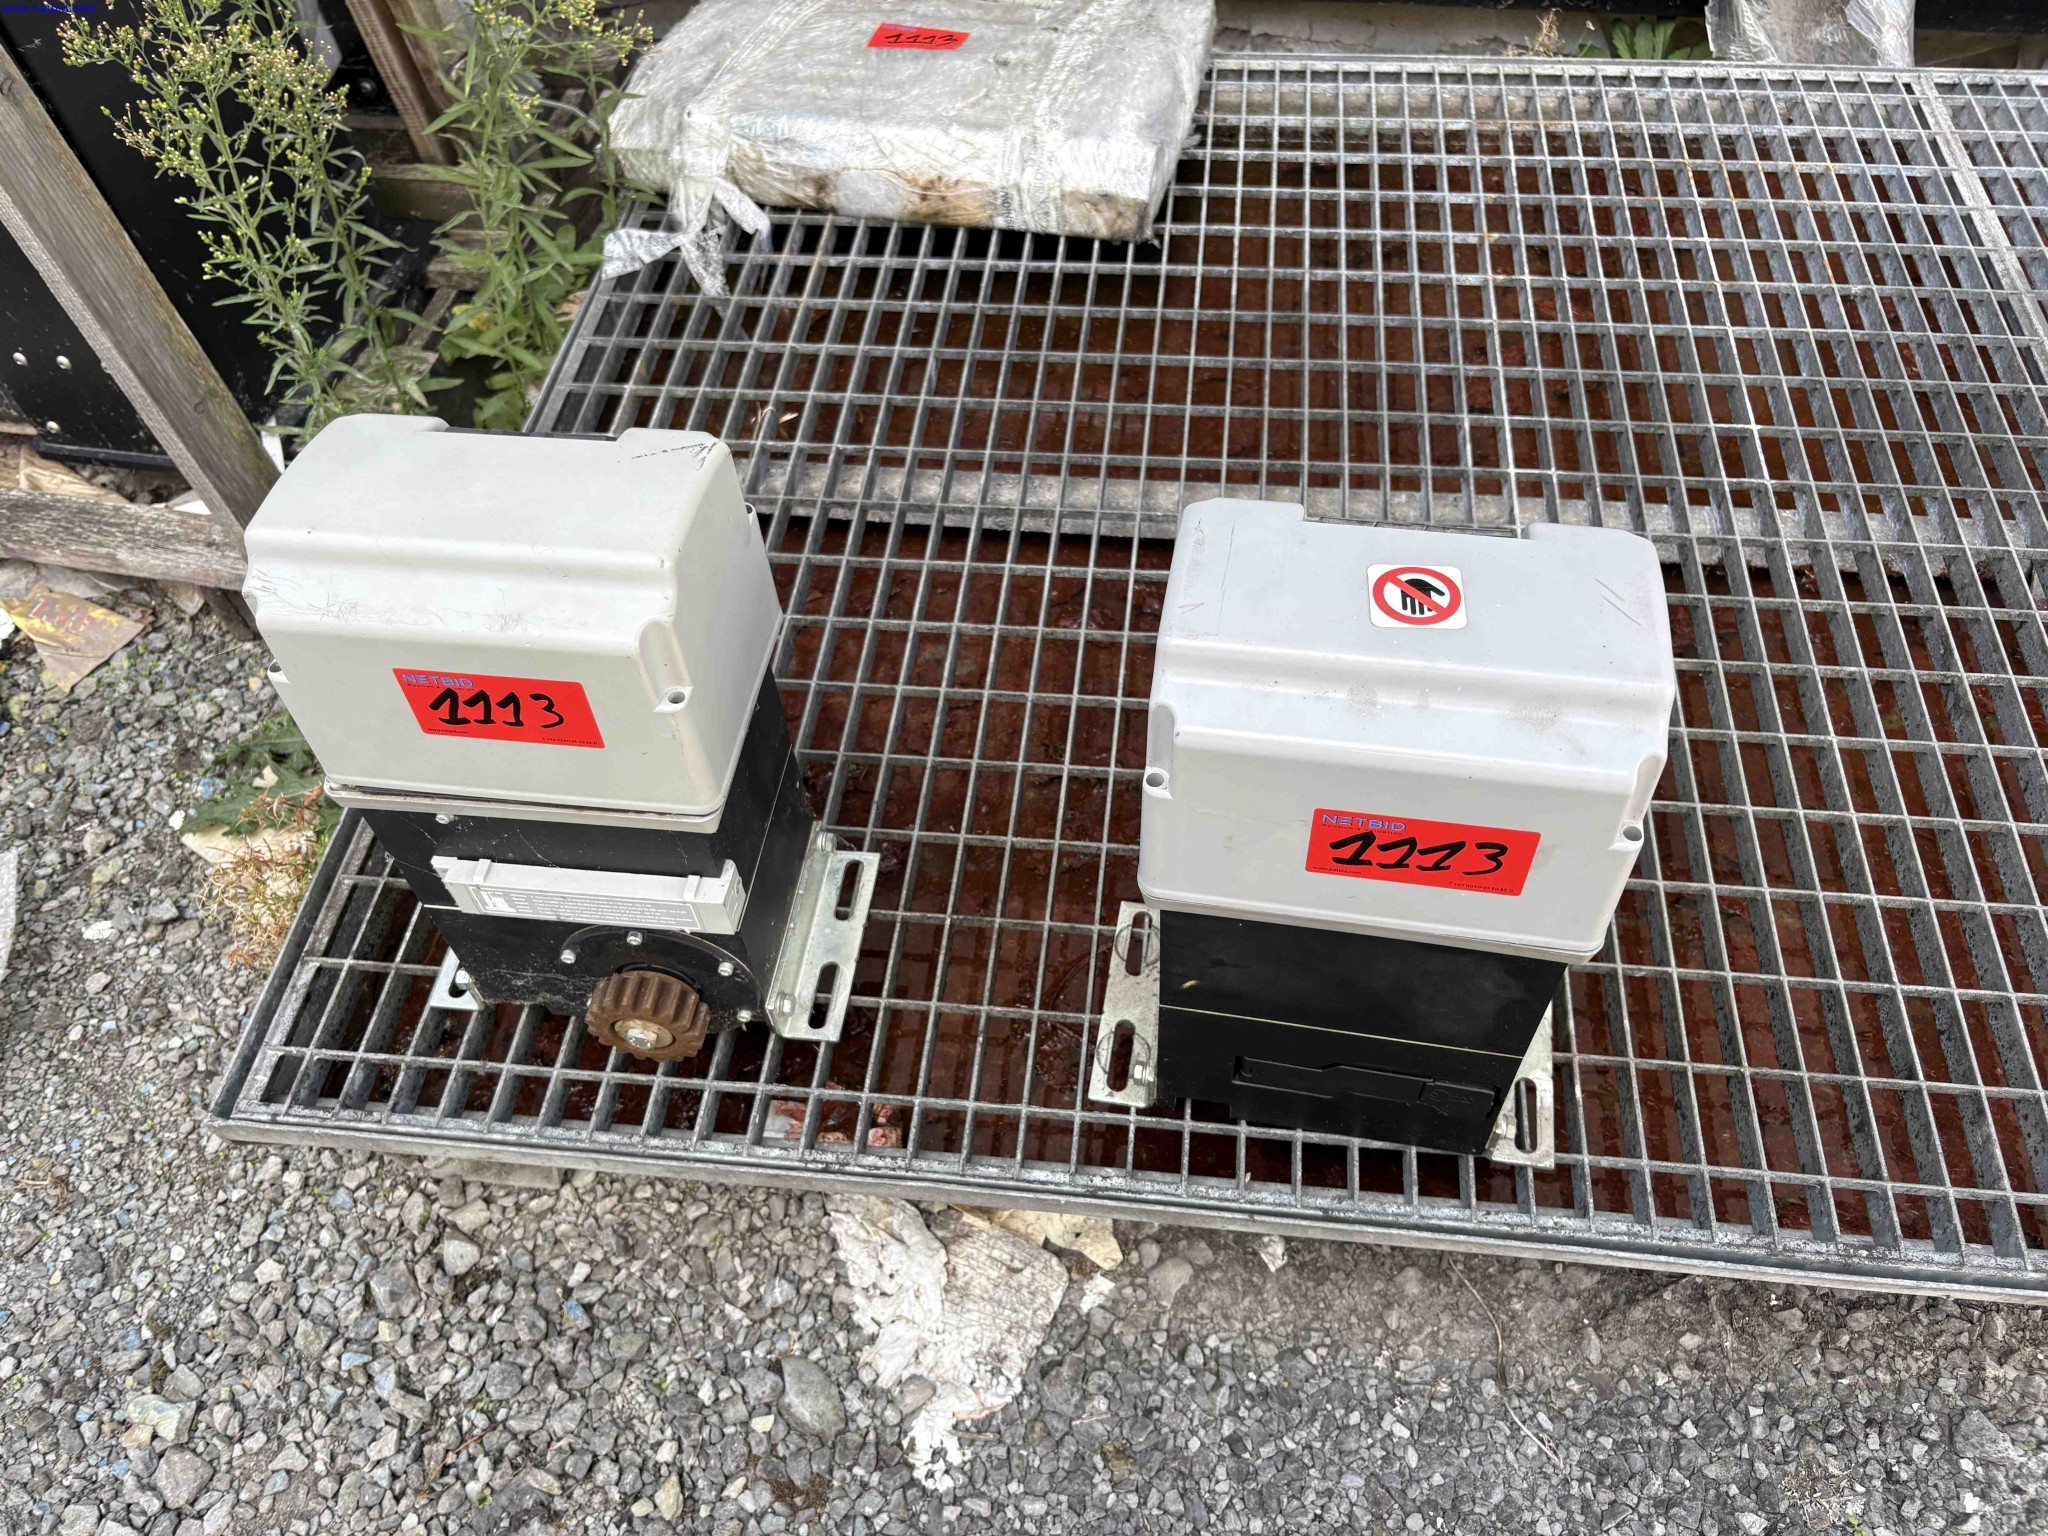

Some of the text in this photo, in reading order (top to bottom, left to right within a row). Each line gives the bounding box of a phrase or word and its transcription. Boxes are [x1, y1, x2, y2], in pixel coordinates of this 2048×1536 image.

[884, 33, 958, 46] 1113
[402, 673, 474, 688] NETBID
[429, 687, 565, 728] 1113
[1322, 814, 1407, 831] NETBID
[1329, 831, 1508, 876] 1113
